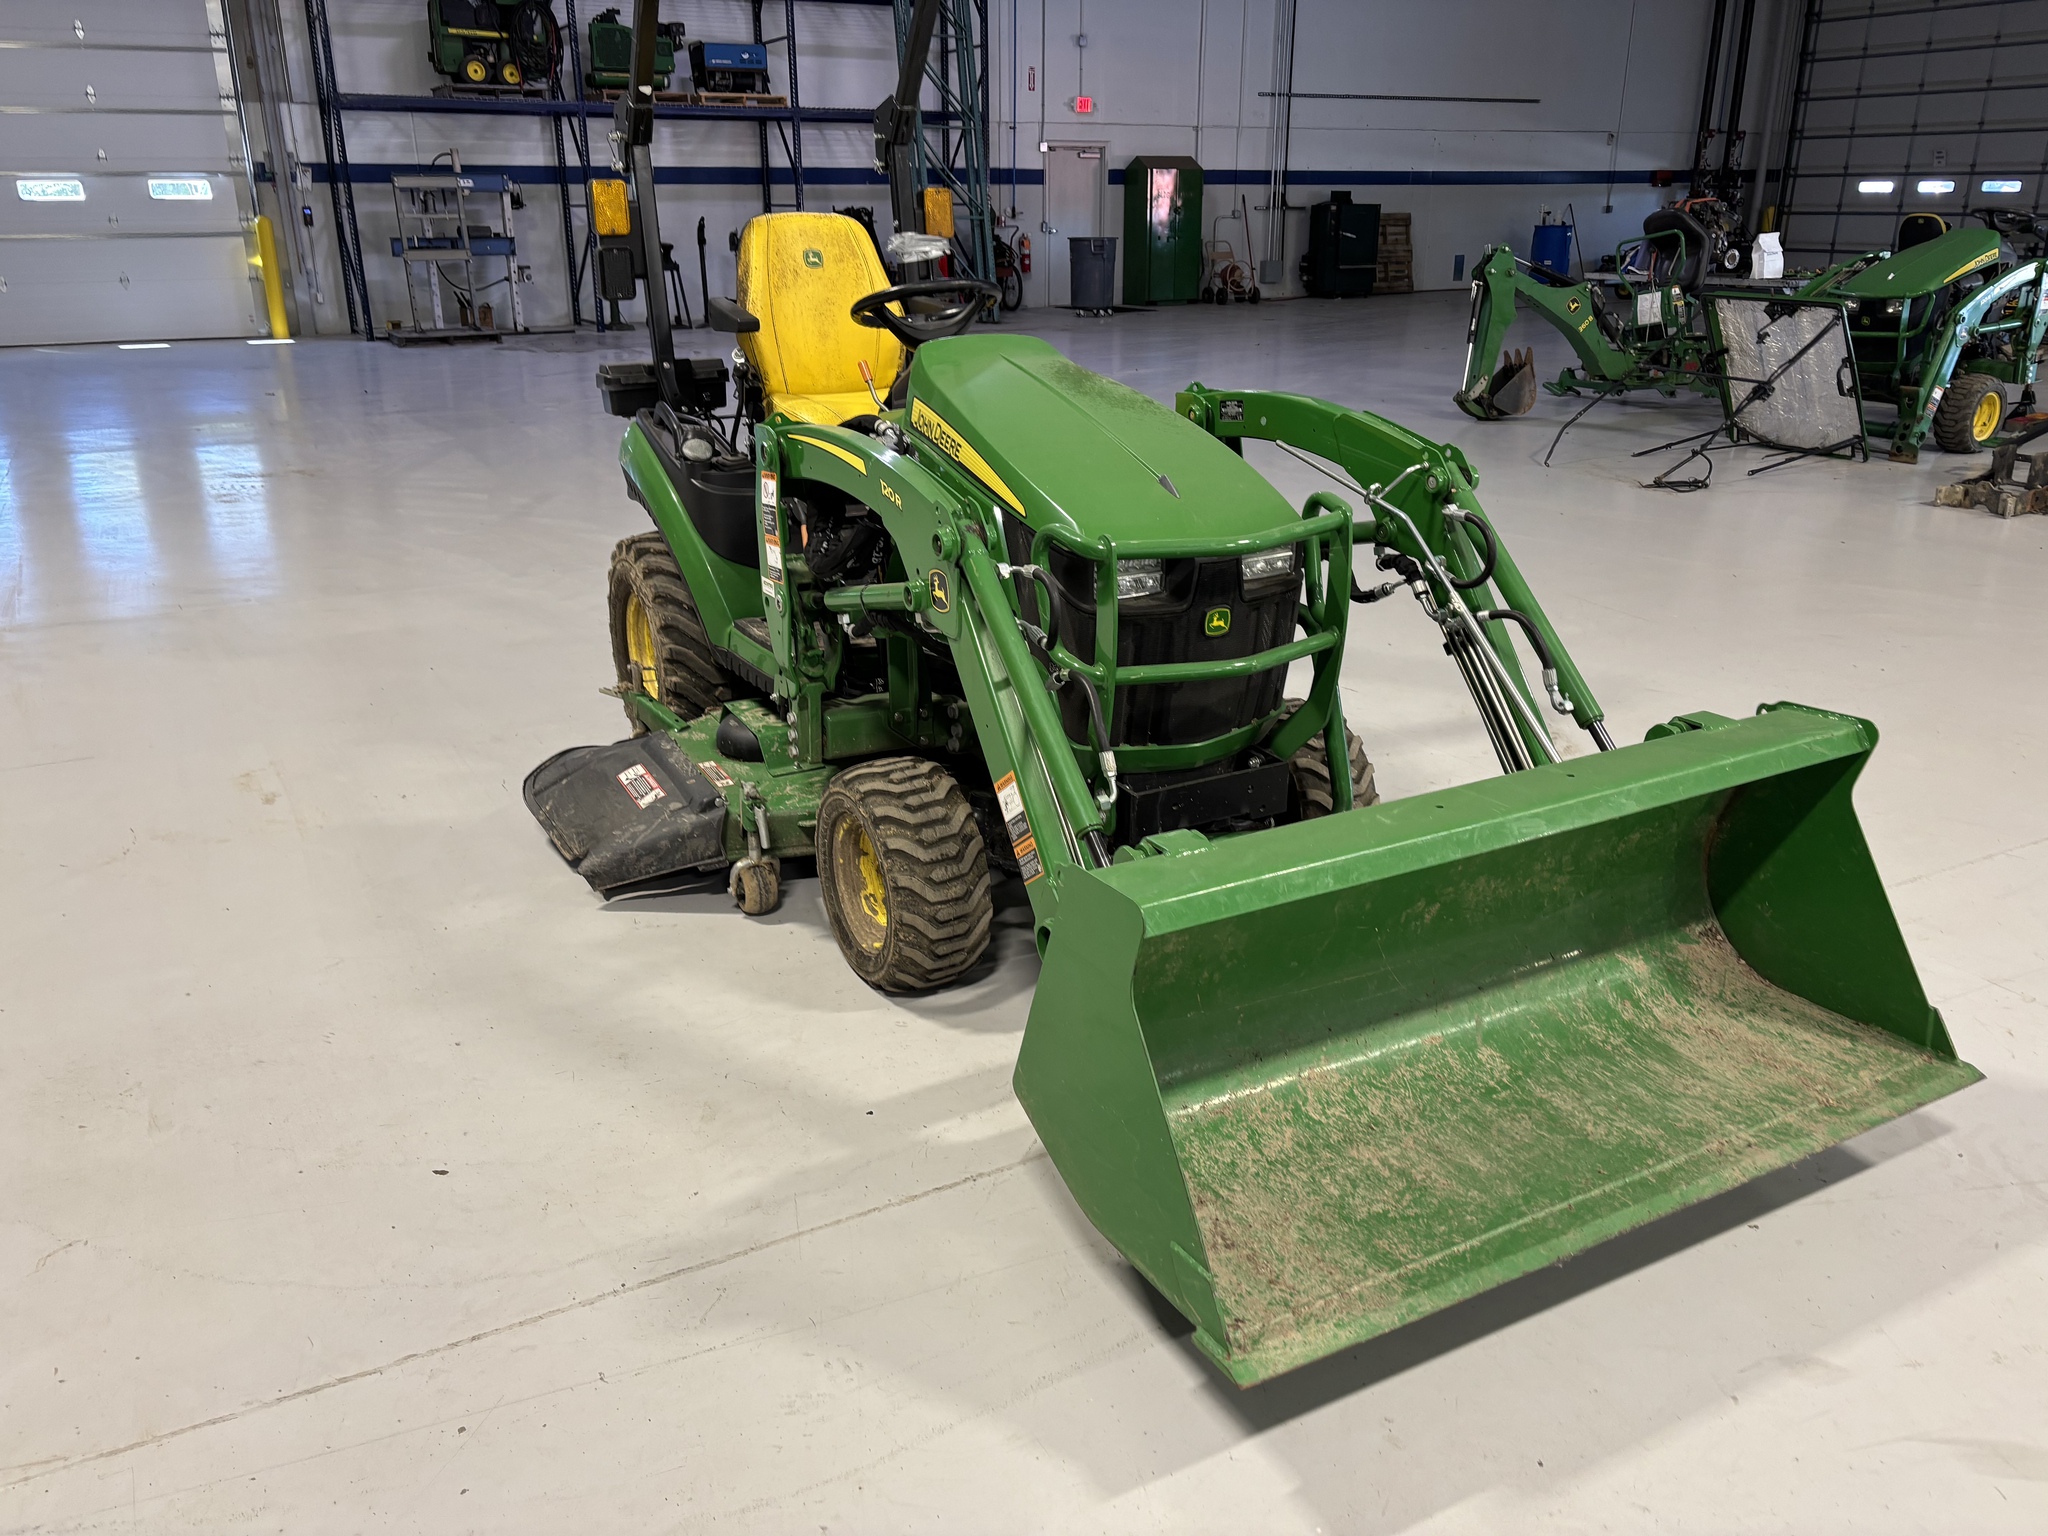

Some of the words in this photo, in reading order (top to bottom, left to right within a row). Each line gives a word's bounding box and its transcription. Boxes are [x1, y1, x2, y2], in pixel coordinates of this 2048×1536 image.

[1077, 97, 1091, 112] EXIT
[914, 408, 935, 439] JOHN
[934, 421, 962, 461] DEERE
